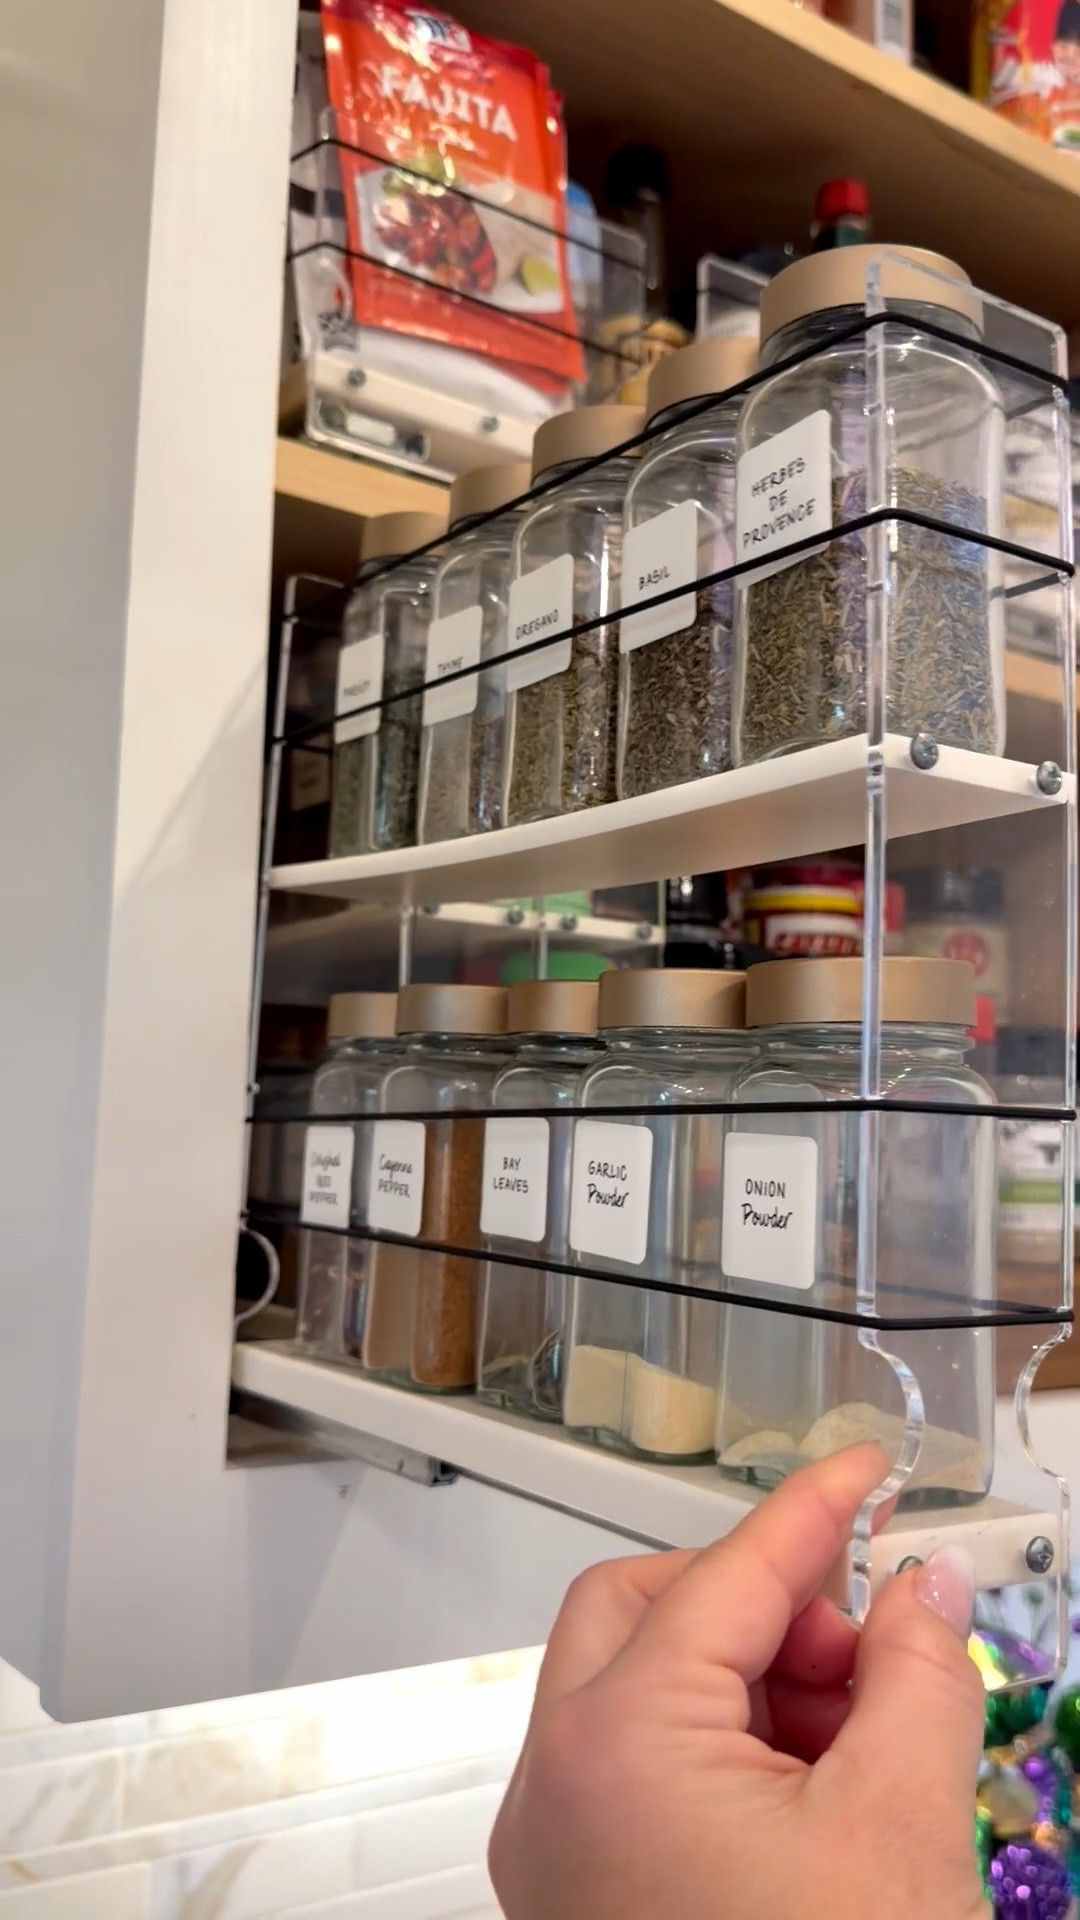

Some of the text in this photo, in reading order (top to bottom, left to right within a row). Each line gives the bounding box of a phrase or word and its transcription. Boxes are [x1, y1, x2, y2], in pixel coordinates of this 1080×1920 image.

[378, 62, 519, 142] FAJITA
[751, 457, 807, 498] HERBES
[768, 490, 789, 512] DE
[742, 498, 817, 548] PROVENCE
[638, 565, 671, 591] BASIL
[515, 609, 559, 641] OREGANO
[502, 1157, 521, 1171] BAY
[588, 1159, 628, 1182] GARLIC
[378, 1178, 411, 1199] PEPPER
[493, 1177, 529, 1194] LEAVES
[587, 1183, 630, 1209] Powder
[745, 1178, 786, 1199] ONION
[741, 1202, 793, 1230] Powder
